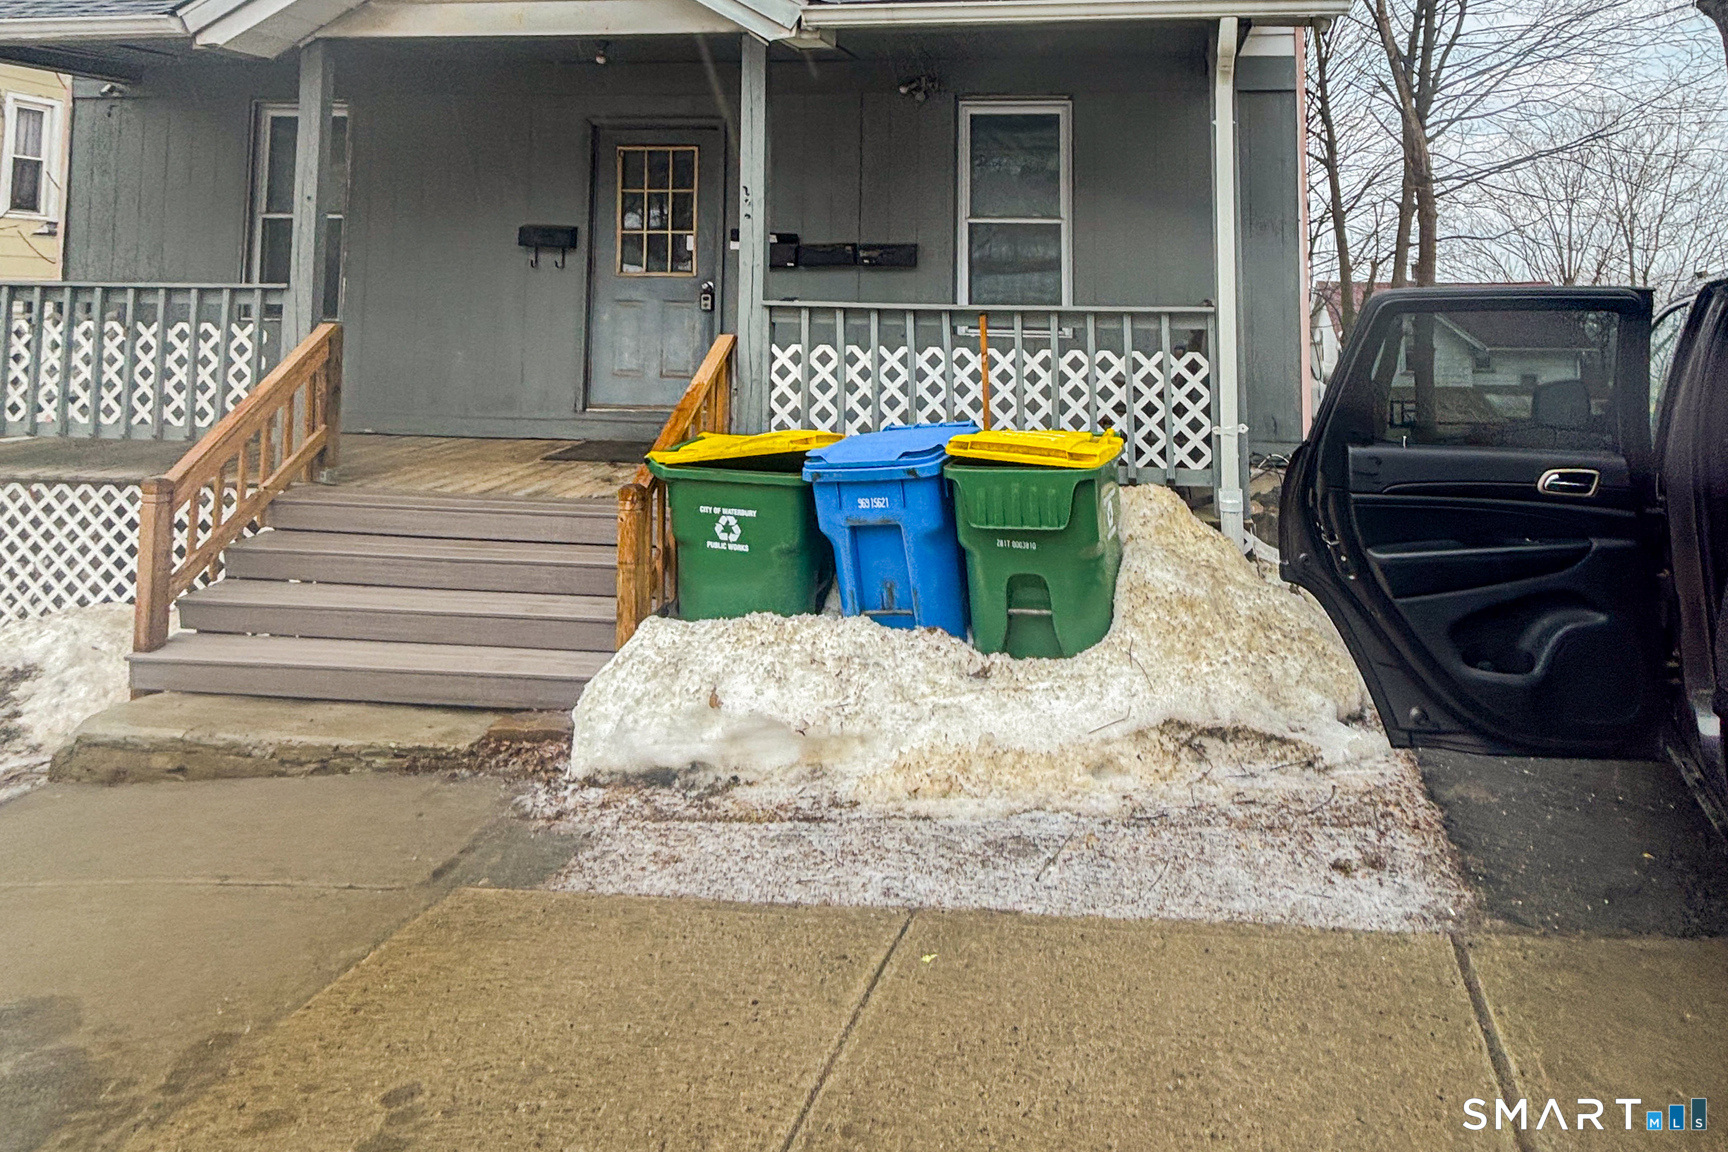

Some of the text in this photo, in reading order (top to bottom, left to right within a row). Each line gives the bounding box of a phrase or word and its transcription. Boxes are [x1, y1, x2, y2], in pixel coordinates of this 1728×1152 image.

[699, 506, 713, 514] CITY
[722, 508, 757, 517] WATERBURY
[706, 541, 749, 552] PUBLIC WORKS
